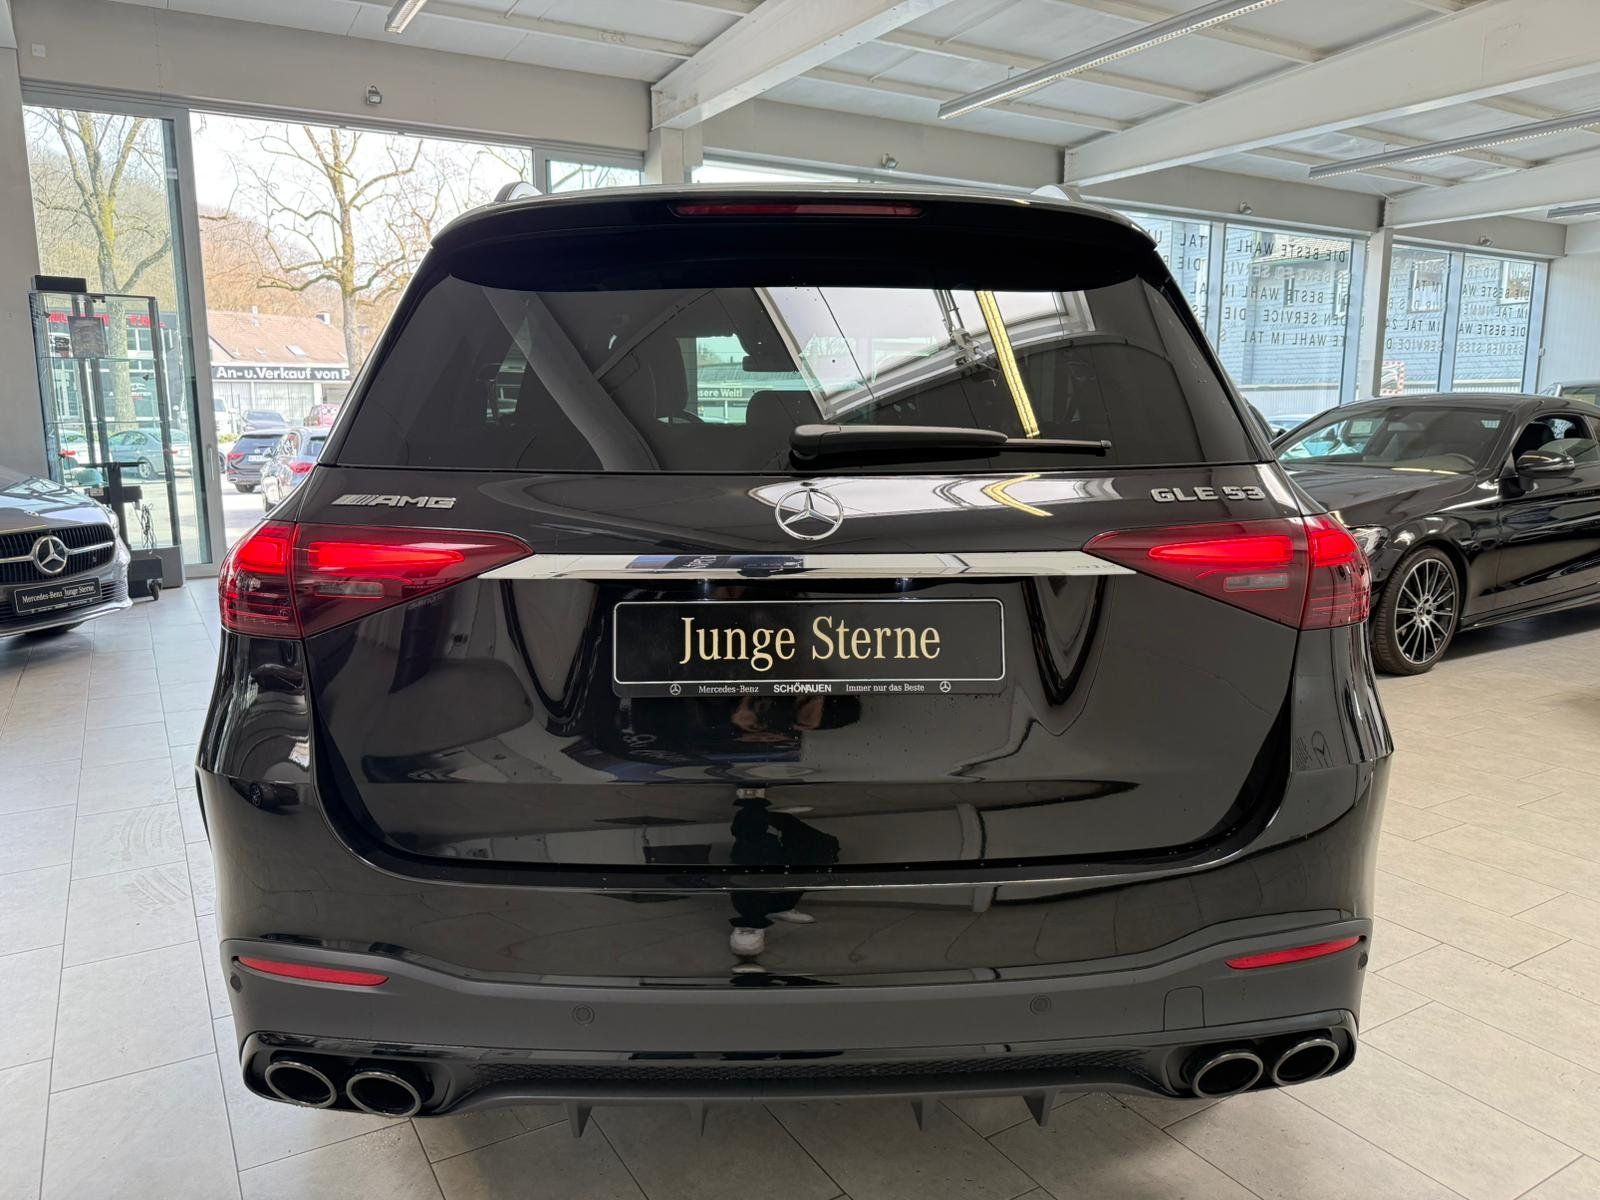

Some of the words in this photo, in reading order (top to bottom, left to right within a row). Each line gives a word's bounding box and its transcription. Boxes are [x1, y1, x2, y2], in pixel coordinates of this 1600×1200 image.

[314, 370, 339, 379] von
[1151, 486, 1219, 502] GLE
[1221, 486, 1266, 500] 53
[374, 495, 456, 509] AMG
[22, 590, 63, 604] Mercedes-Benz
[680, 617, 796, 672] Junge
[812, 615, 942, 661] Sterne
[698, 685, 760, 695] Mercedes-Benz
[773, 682, 832, 694] SCHÖNAUEN
[846, 684, 871, 693] Immer
[888, 684, 903, 692] das
[904, 684, 925, 693] Beste
